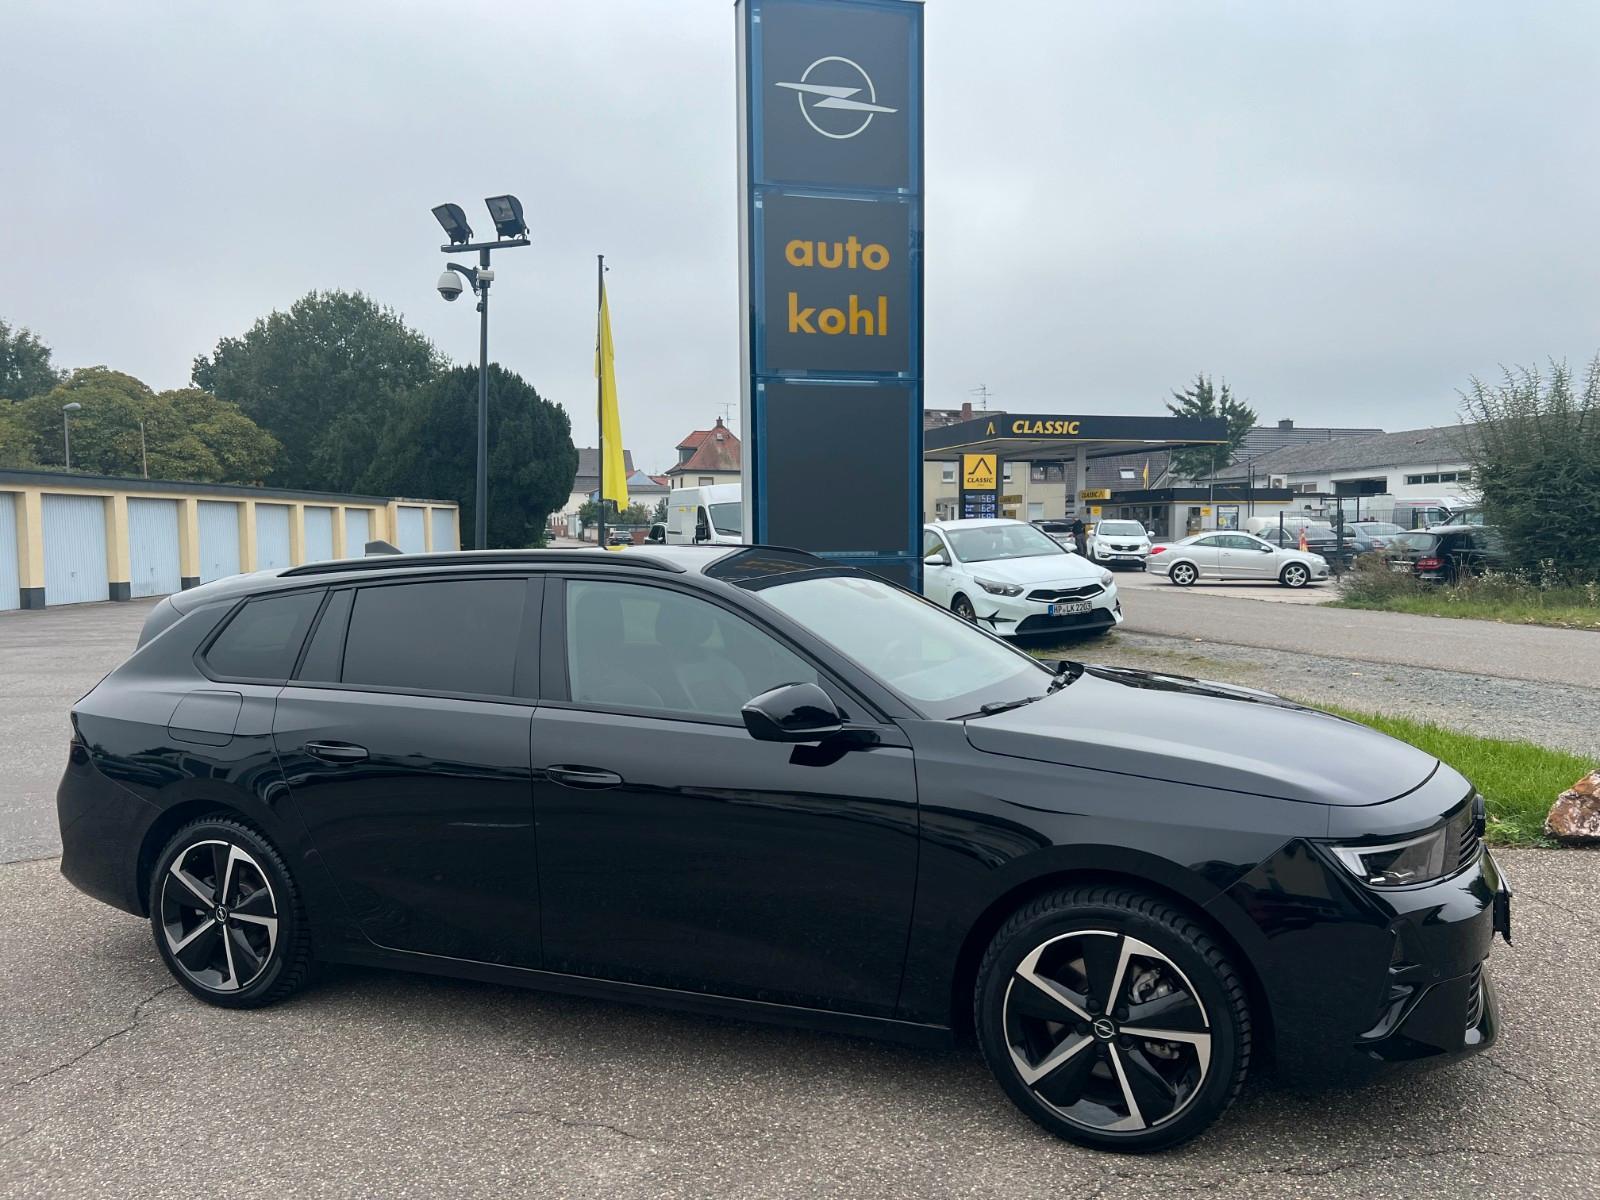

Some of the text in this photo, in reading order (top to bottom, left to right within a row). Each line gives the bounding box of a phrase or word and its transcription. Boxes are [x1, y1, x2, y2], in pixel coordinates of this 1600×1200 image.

[785, 235, 890, 271] auto
[787, 292, 888, 336] kohl
[1012, 420, 1080, 435] CLASSIC
